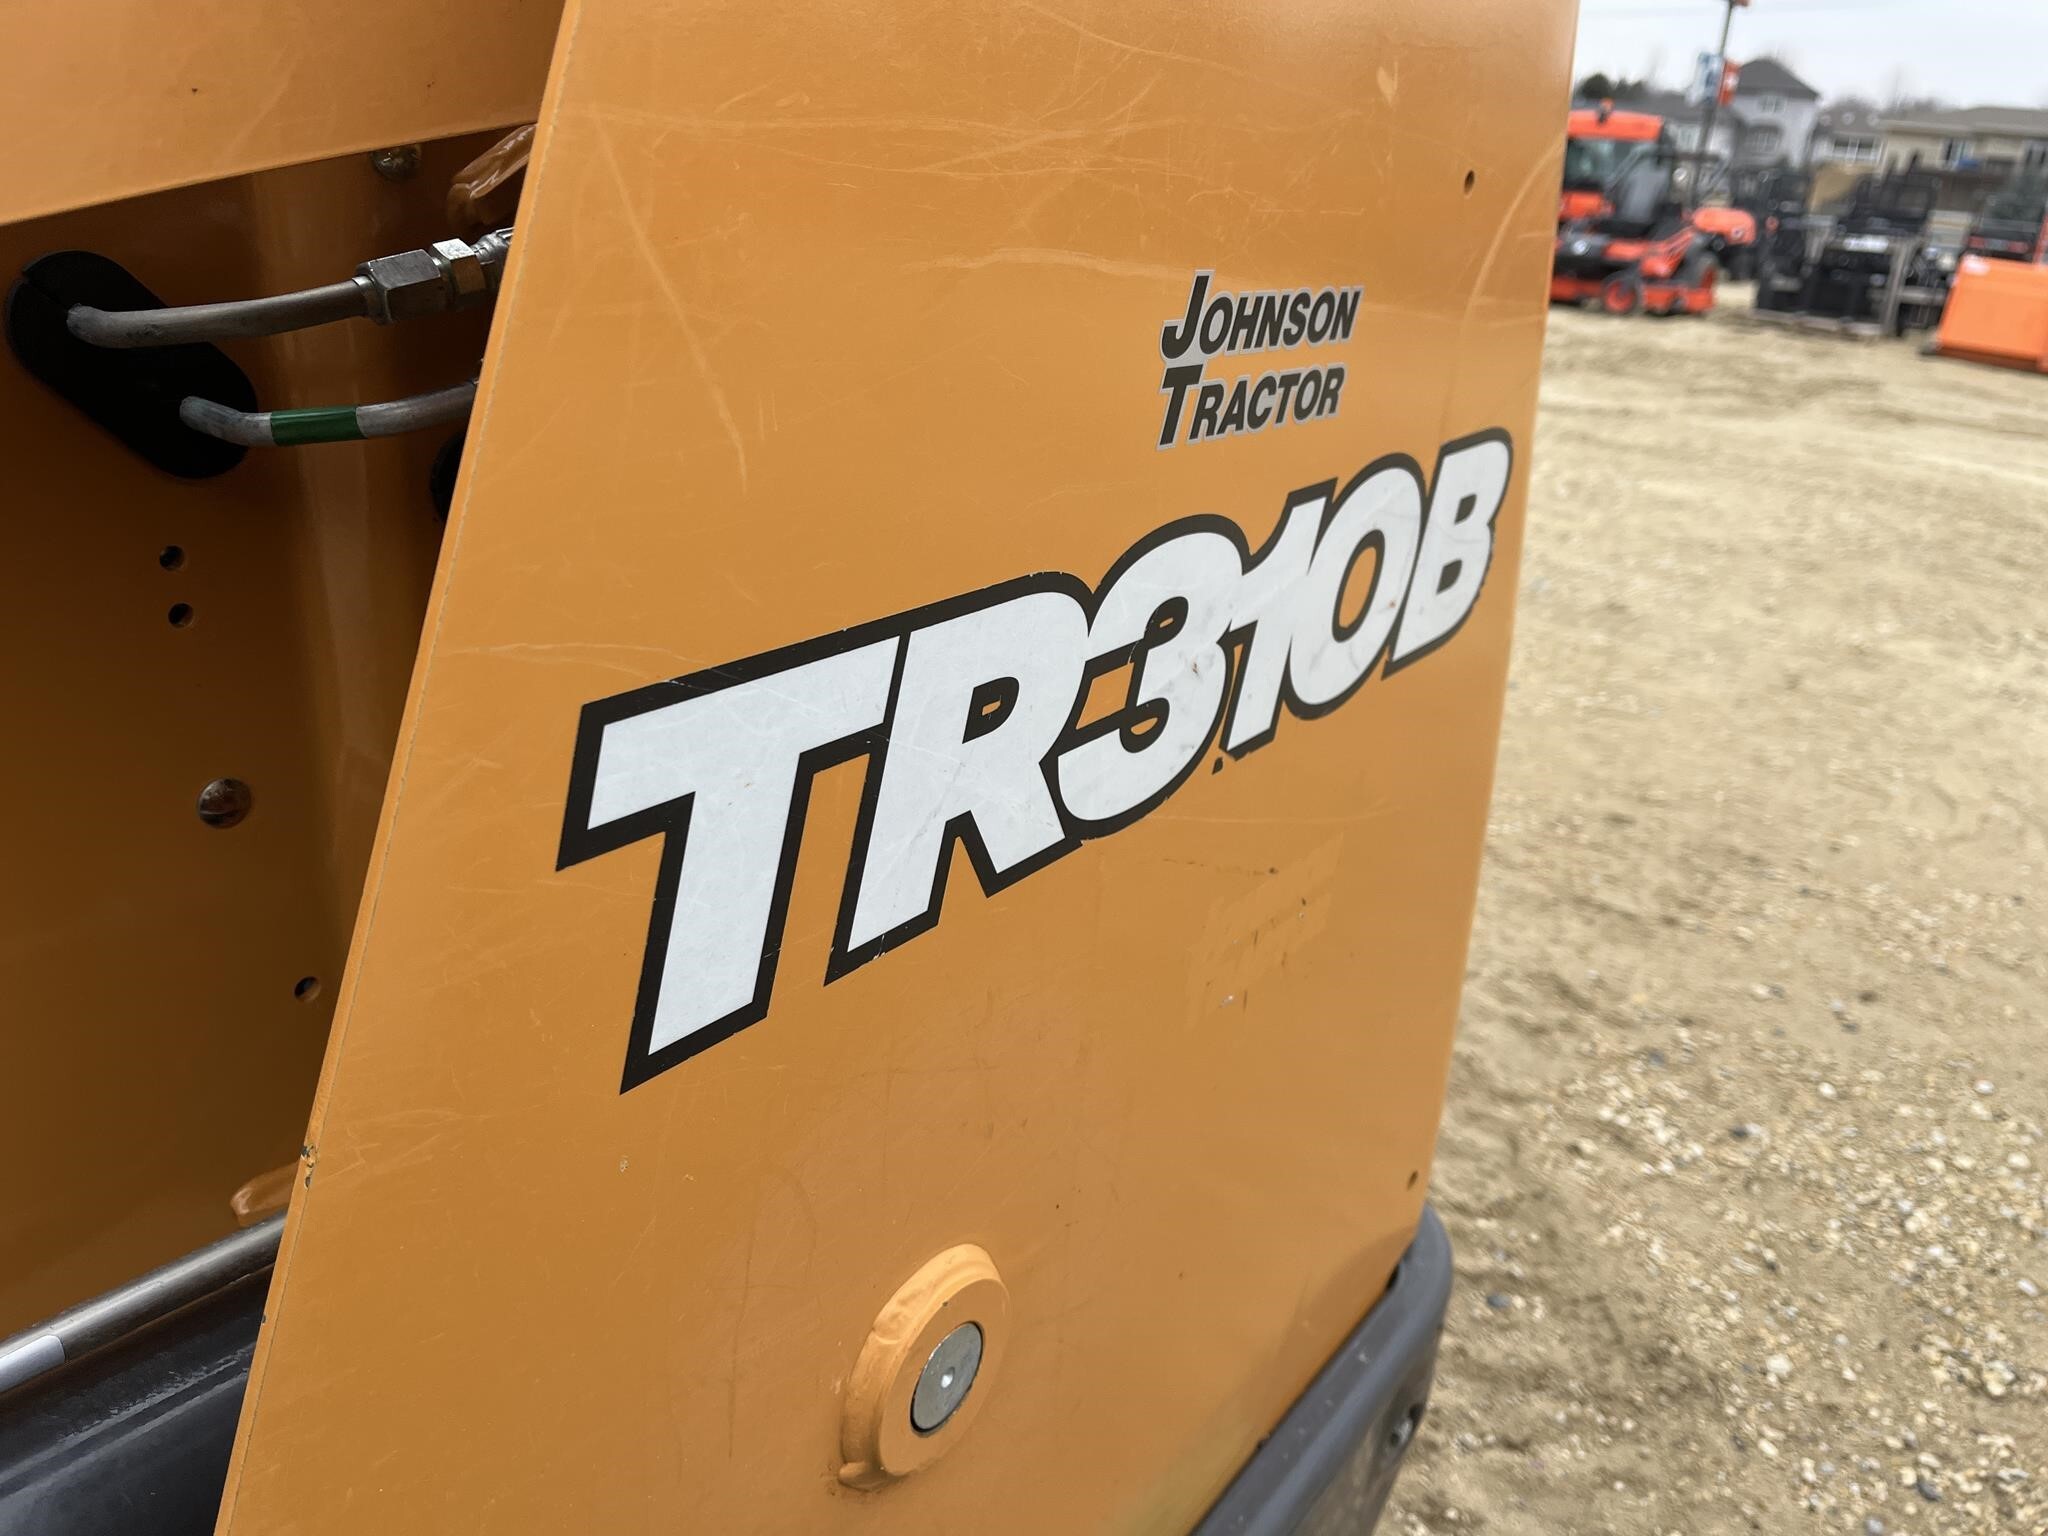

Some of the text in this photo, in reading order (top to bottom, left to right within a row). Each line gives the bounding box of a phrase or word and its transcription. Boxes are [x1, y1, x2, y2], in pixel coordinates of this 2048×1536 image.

[1161, 274, 1361, 360] JOHNSON
[1158, 363, 1345, 447] TRACTOR
[560, 430, 1512, 1090] TR310B
